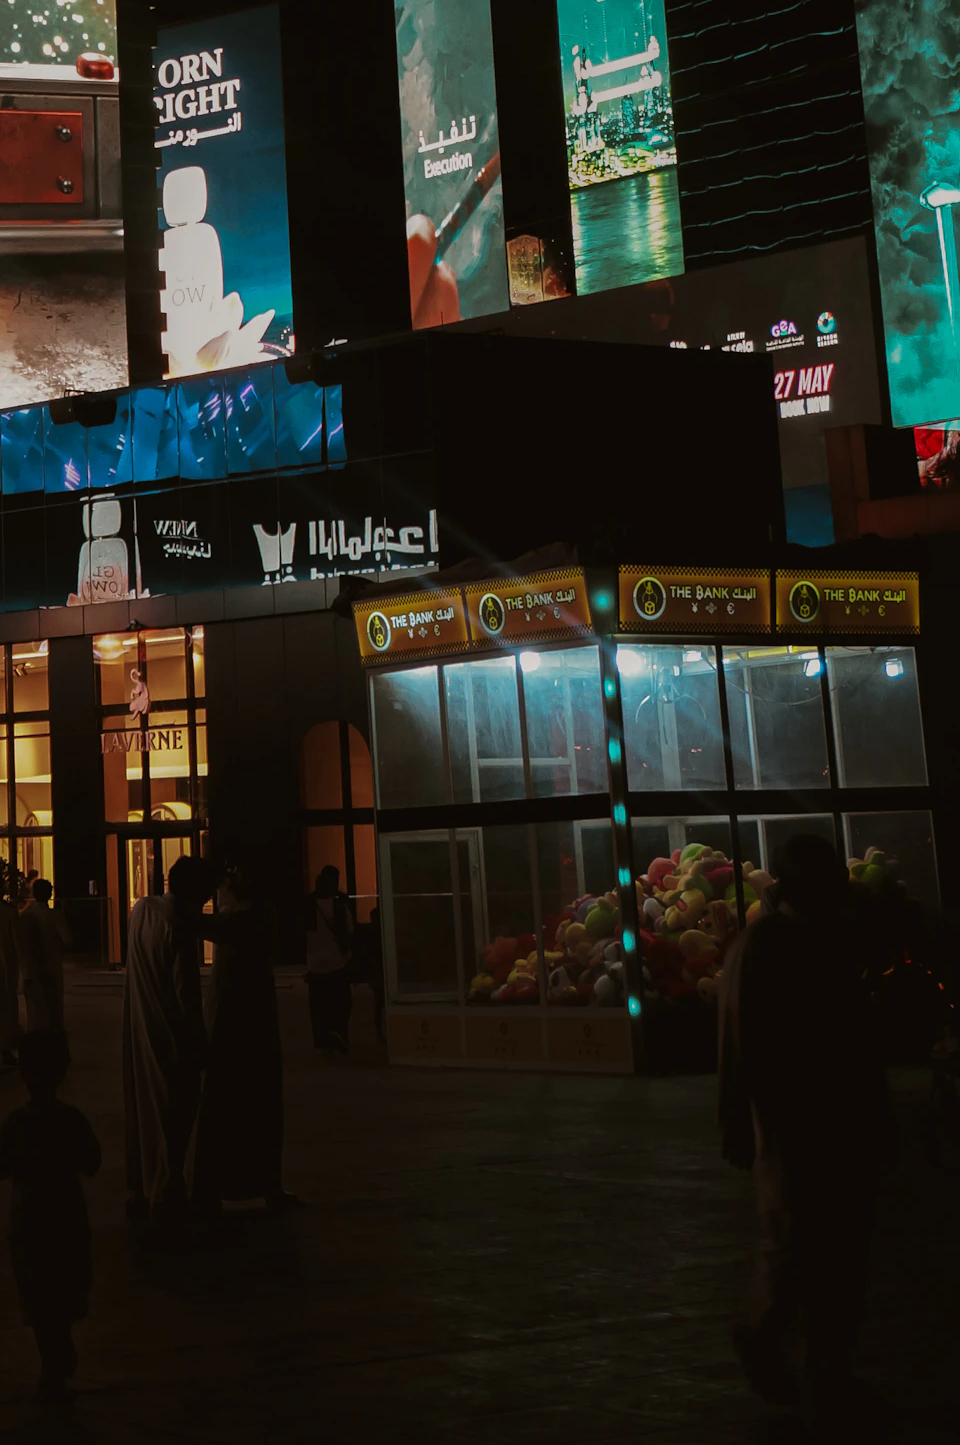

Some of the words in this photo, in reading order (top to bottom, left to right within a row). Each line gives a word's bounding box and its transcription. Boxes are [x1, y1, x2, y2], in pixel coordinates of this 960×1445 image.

[418, 115, 476, 154] تنفيذ
[424, 152, 472, 178] Execution
[774, 370, 794, 399] 27
[797, 363, 834, 395] MAY
[669, 585, 692, 599] THE
[824, 589, 845, 601] THE
[505, 597, 523, 610] THE
[390, 614, 408, 629] THE
[100, 730, 183, 754] LAVERNE
